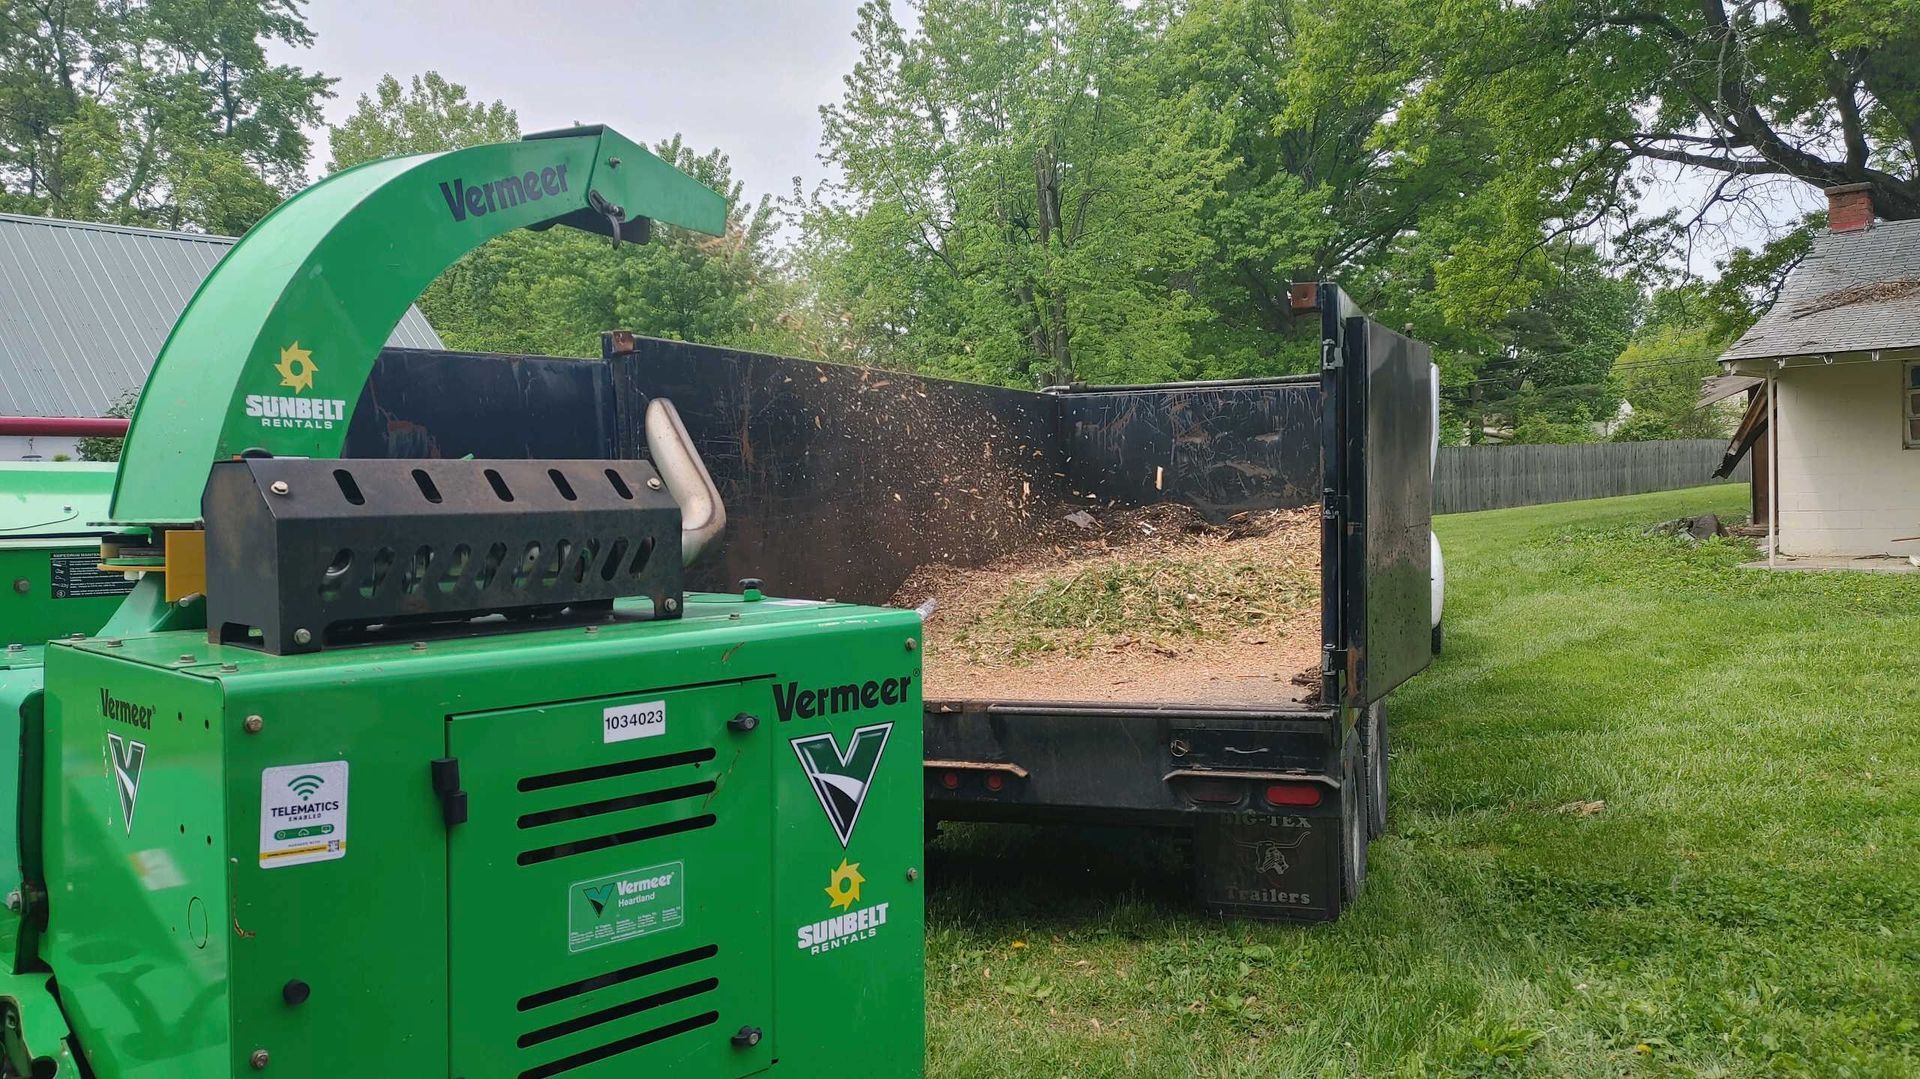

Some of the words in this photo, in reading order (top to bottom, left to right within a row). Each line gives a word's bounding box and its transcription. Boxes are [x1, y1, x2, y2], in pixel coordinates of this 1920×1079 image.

[439, 164, 567, 222] Vermeer
[246, 395, 346, 420] SUNBELT
[261, 418, 333, 430] RENTALS
[100, 687, 152, 730] Vermeer
[605, 710, 664, 731] 1034023
[271, 801, 339, 817] TELEMATICS
[288, 813, 322, 822] ENABLED
[616, 875, 672, 896] Vermeer
[1224, 885, 1311, 905] Trailers
[618, 892, 656, 908] Heartland
[797, 902, 889, 949] SUNBELT
[811, 928, 877, 956] RENTALS
